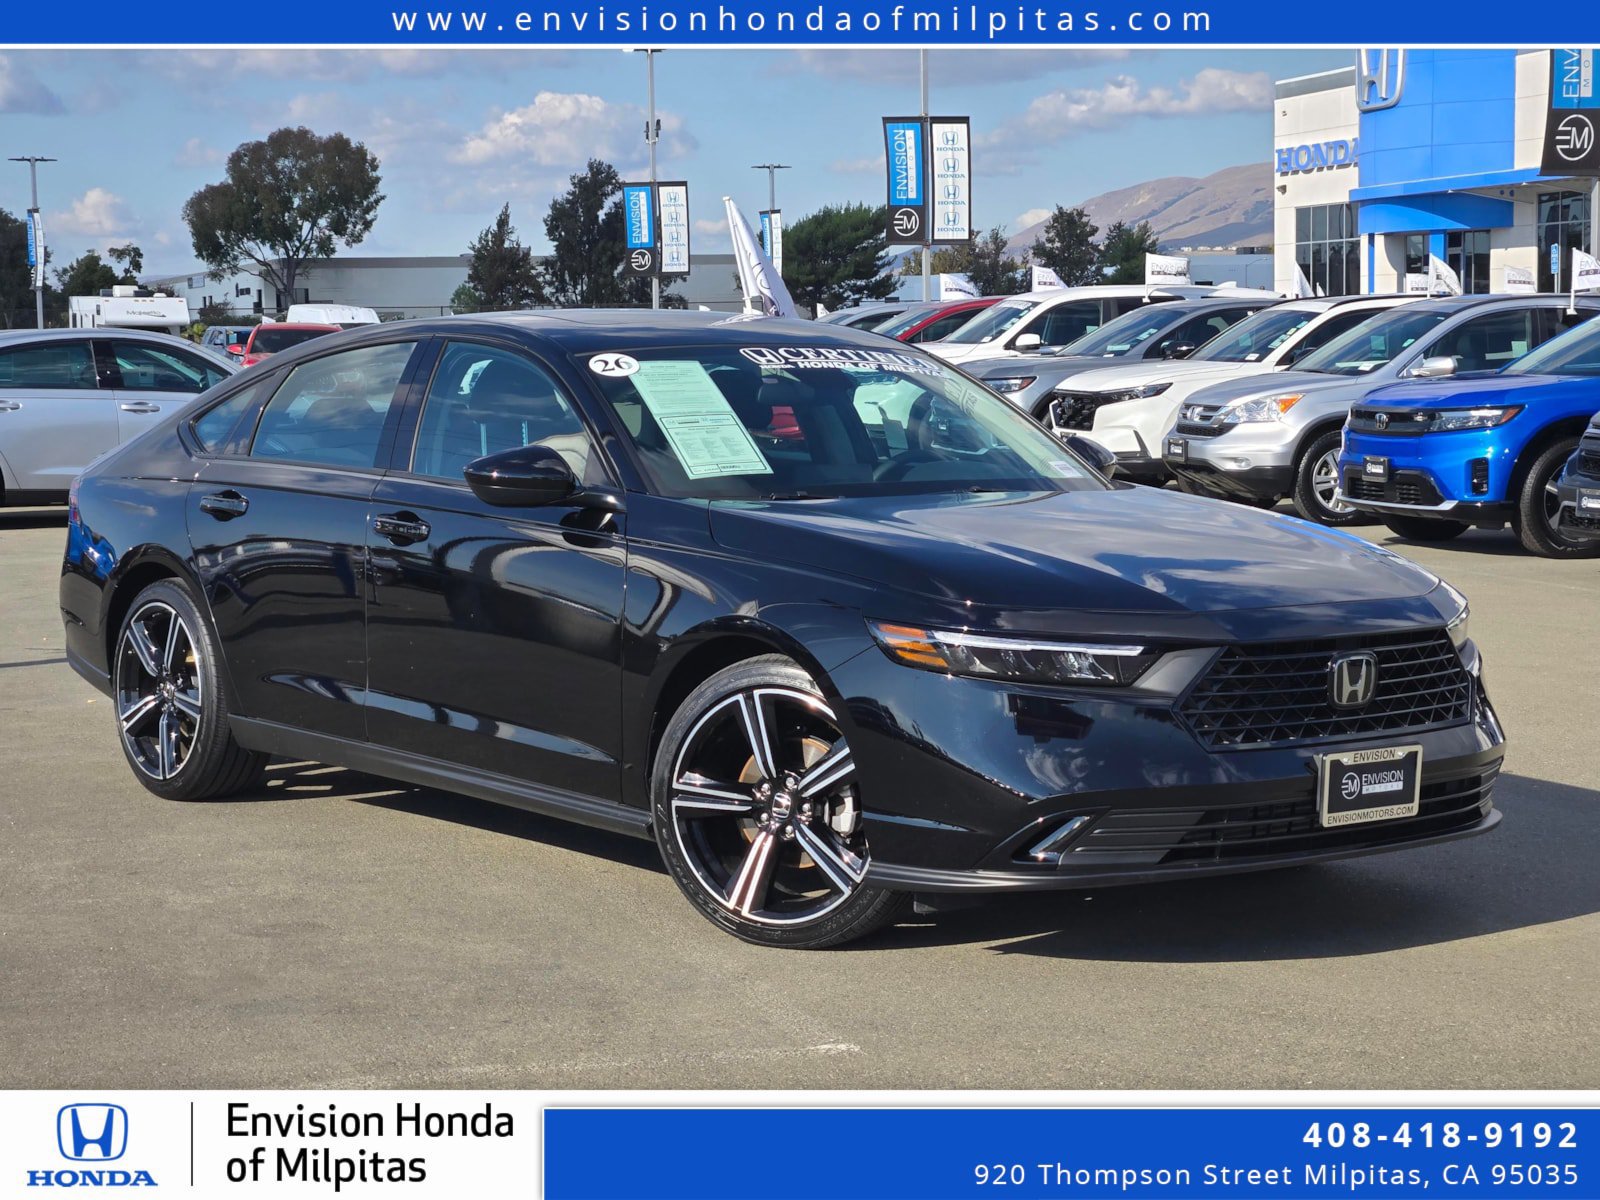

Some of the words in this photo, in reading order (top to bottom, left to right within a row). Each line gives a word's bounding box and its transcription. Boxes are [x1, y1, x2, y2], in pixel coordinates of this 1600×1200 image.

[893, 129, 908, 199] ENVISION
[630, 191, 642, 244] ENVISION
[593, 358, 633, 373] 26
[778, 347, 939, 371] CERTIFIED
[797, 361, 856, 369] HONDA
[858, 362, 879, 370] OF
[1353, 749, 1396, 763] ENVISION
[1362, 770, 1404, 786] ENVISION
[1327, 806, 1414, 825] ENVISIONMOTORS.COM
